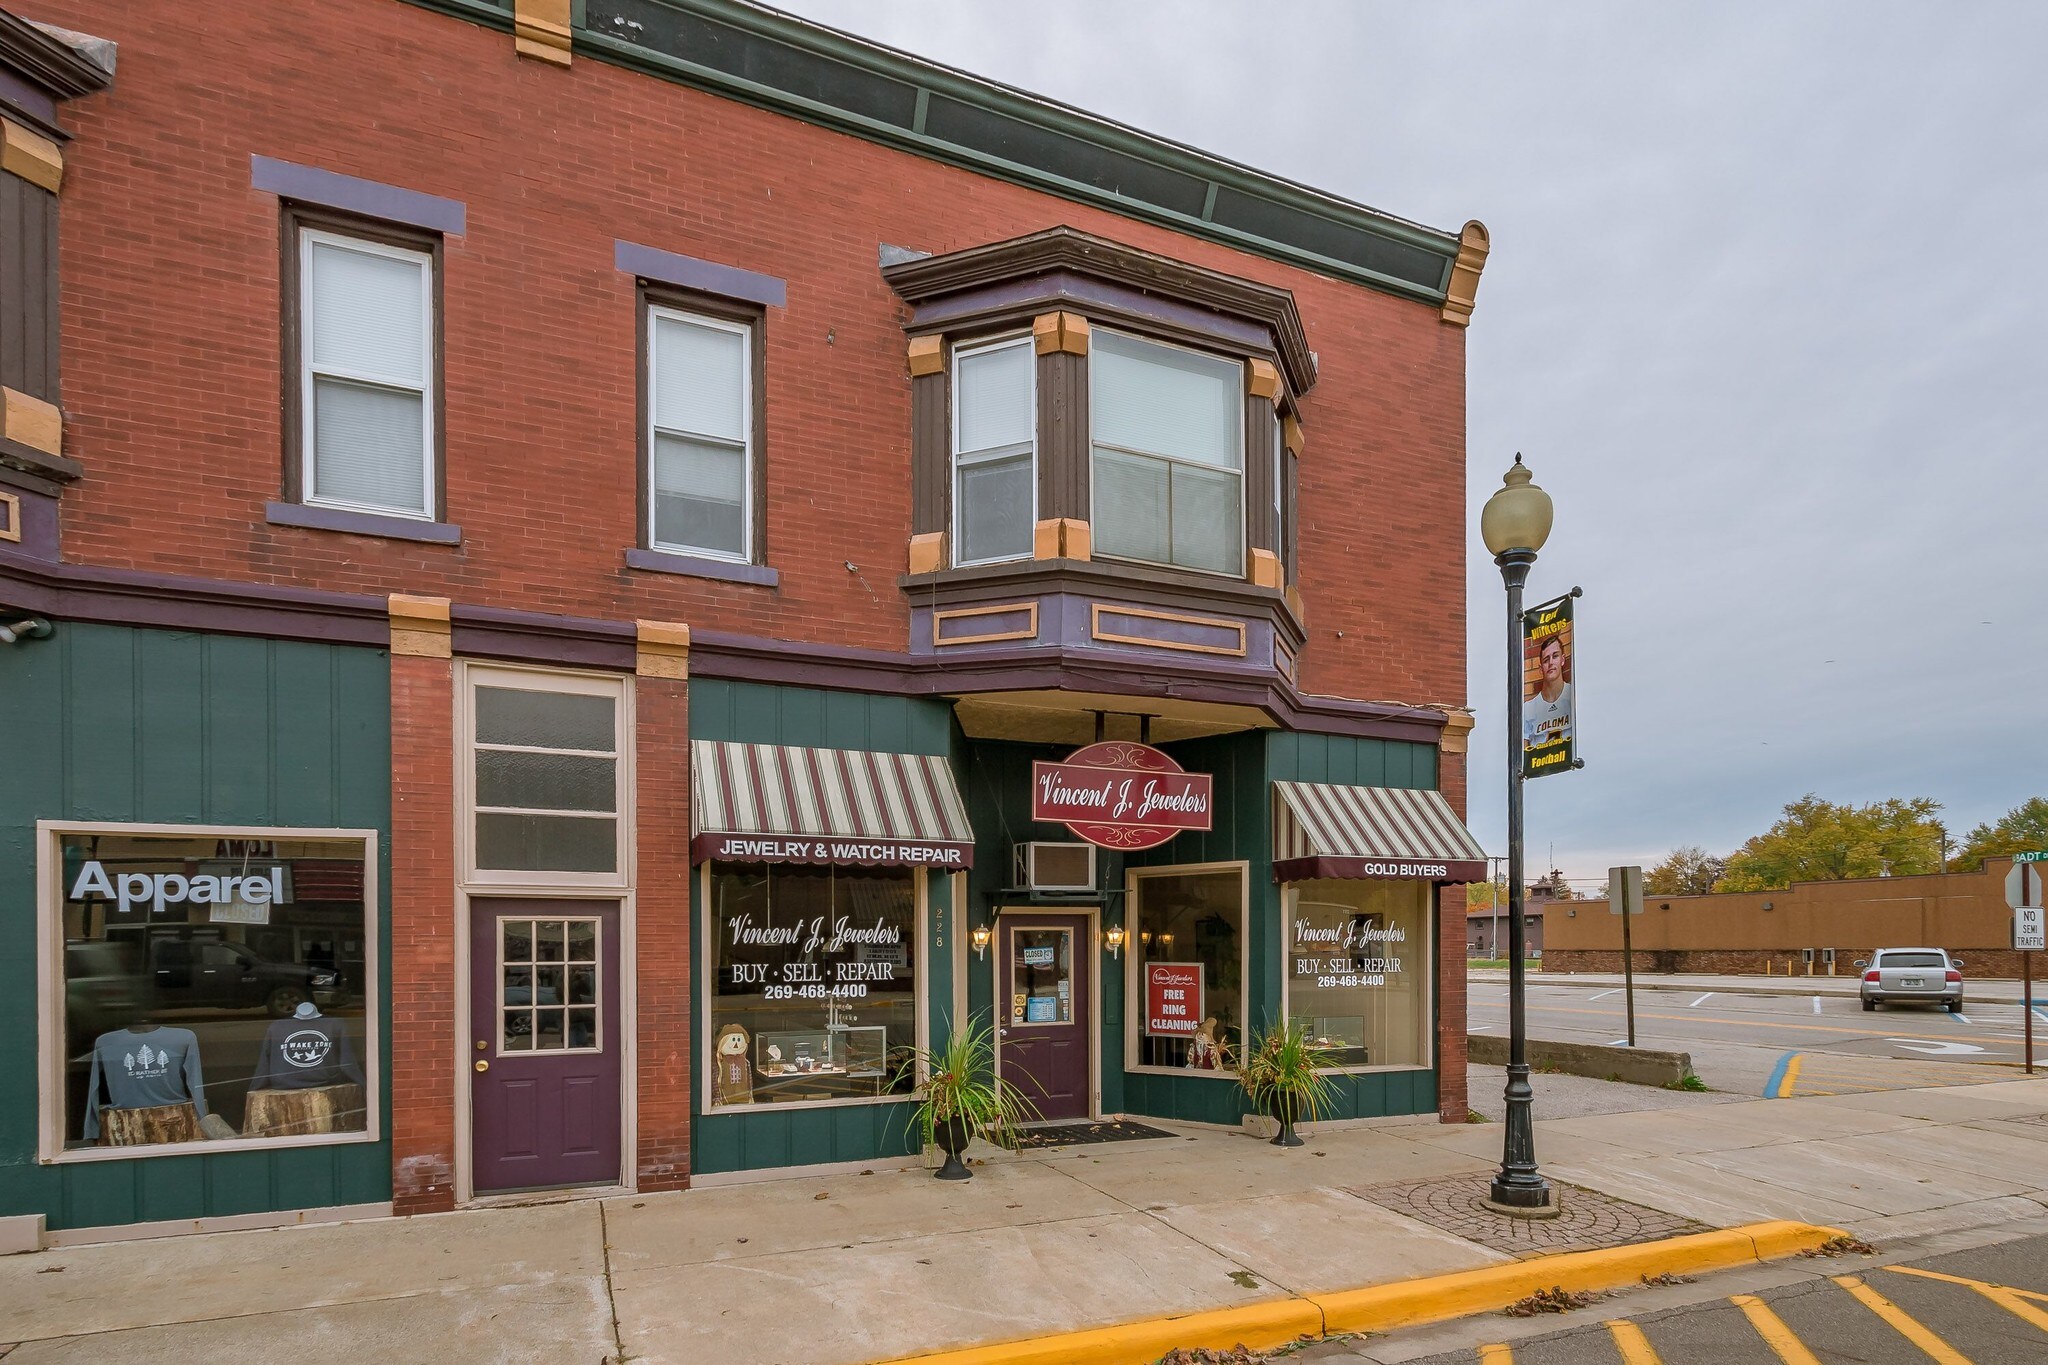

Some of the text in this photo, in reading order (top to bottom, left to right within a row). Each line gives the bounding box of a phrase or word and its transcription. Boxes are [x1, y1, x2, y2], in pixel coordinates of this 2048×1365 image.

[1536, 714, 1569, 733] COLOMA
[1531, 750, 1566, 769] Football
[1039, 771, 1207, 819] Vincent J. Jewelers
[719, 839, 962, 863] JEWELRY & WATCH REPAIR
[1364, 863, 1447, 877] GOLD BUYERS
[69, 861, 284, 912] Apparel
[2023, 910, 2036, 922] NO
[729, 913, 900, 954] Vincent J. Jewelers
[1295, 917, 1405, 950] Vincent J. Jewelers
[2022, 924, 2038, 934] SEMI
[2017, 936, 2043, 946] TRAFFIC
[1025, 950, 1043, 958] CLOSED
[732, 962, 895, 983] BUY SELL REPAIR
[1297, 957, 1402, 974] BUY SELL REPAIR
[1317, 974, 1384, 987] 269-468-4400
[764, 984, 867, 1000] 269-468-4400
[1163, 989, 1185, 1000] FREE
[1162, 1004, 1186, 1015] RING
[1151, 1018, 1198, 1031] CLEANING
